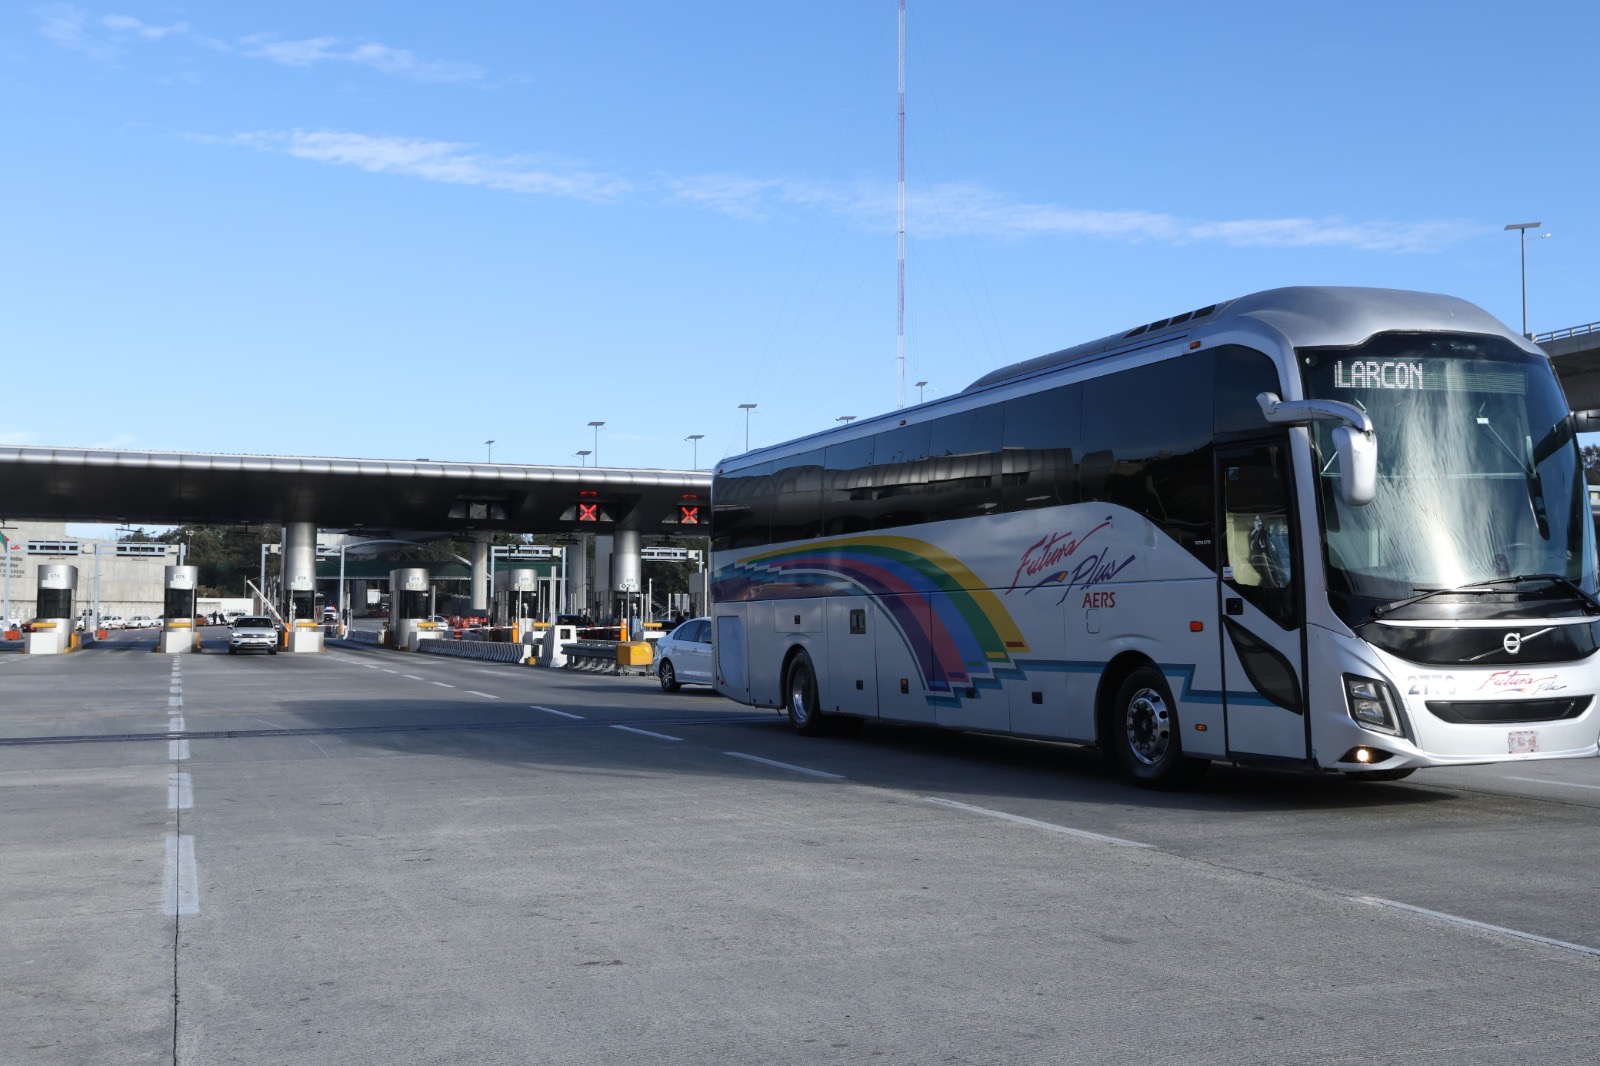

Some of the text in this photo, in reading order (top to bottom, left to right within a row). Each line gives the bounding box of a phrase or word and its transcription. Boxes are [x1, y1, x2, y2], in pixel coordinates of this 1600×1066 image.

[1334, 360, 1423, 389] LARCON
[1005, 515, 1113, 595] Futura
[1056, 547, 1136, 606] Plus
[1082, 592, 1116, 608] AERS
[1476, 670, 1558, 691] Futura
[1531, 681, 1568, 696] Plus
